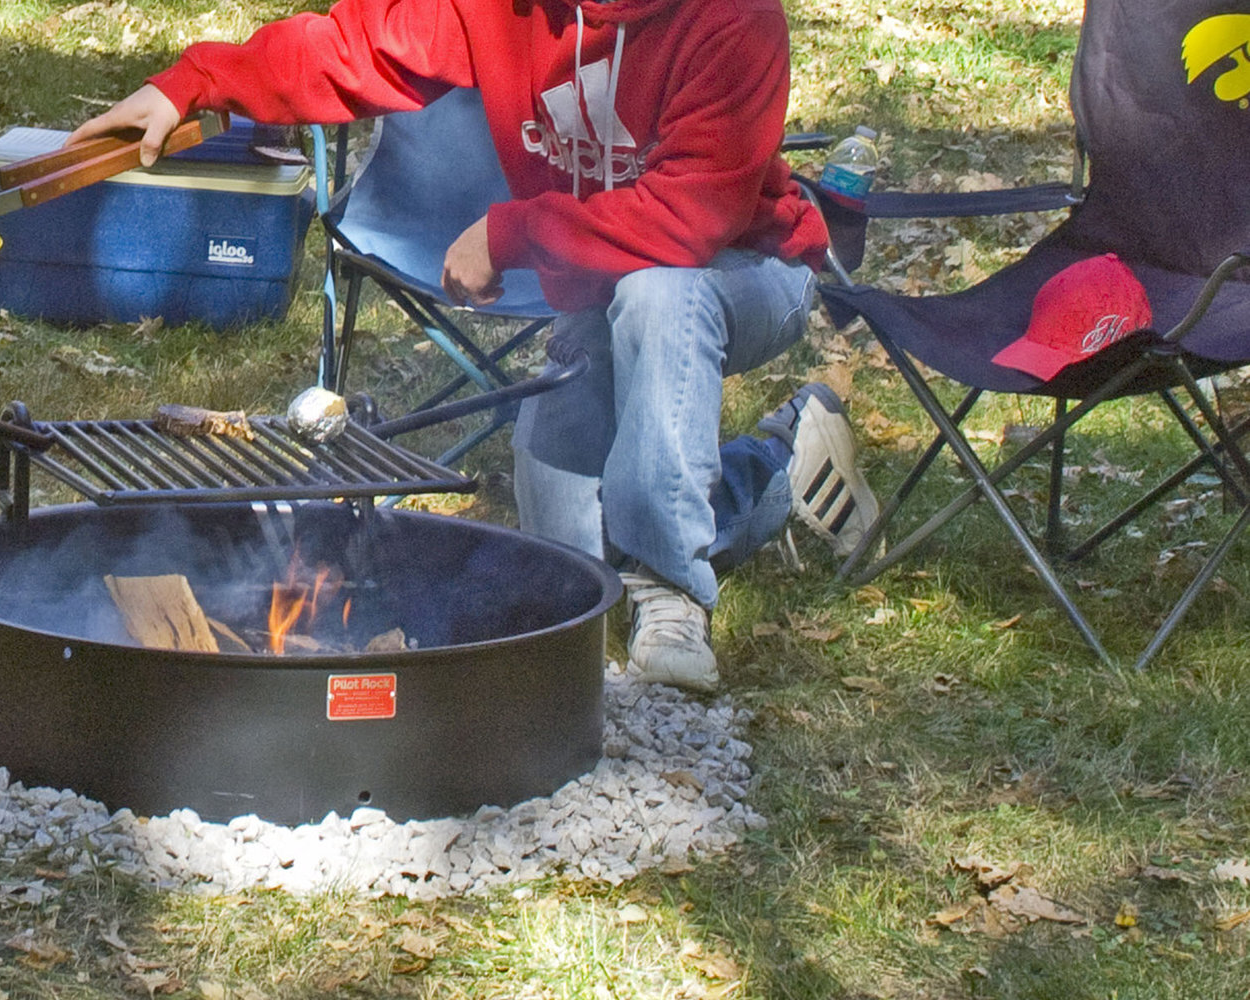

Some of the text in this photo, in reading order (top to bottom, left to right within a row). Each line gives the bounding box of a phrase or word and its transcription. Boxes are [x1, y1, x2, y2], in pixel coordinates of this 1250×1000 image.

[208, 240, 247, 258] igloo
[333, 678, 391, 690] Pilot Rock
